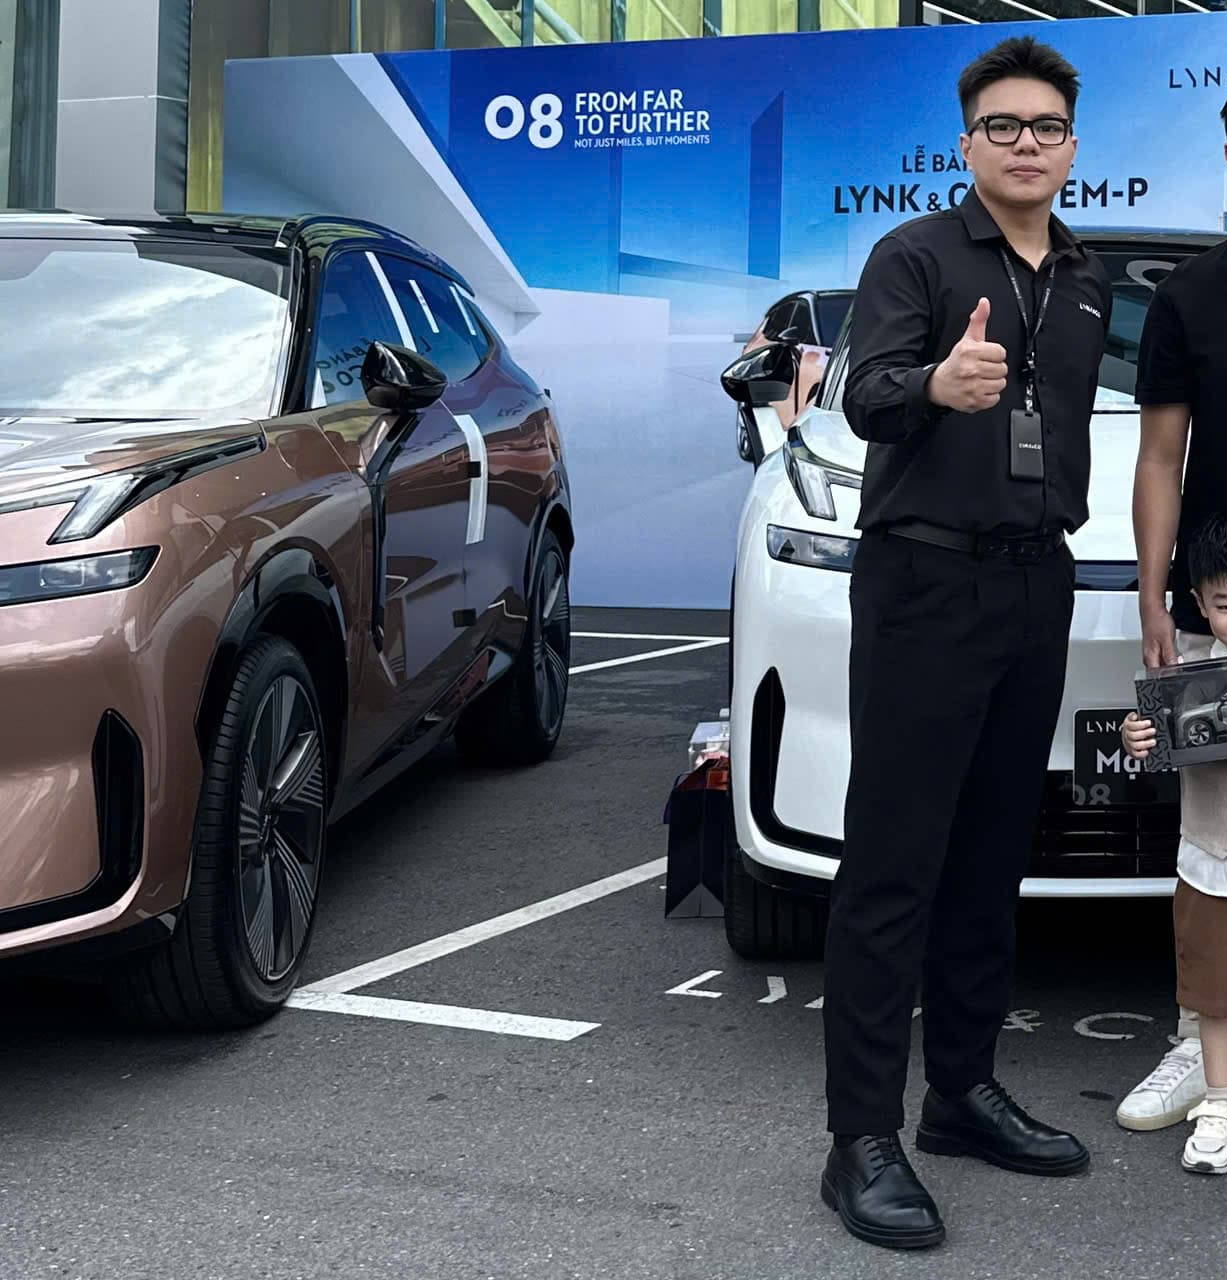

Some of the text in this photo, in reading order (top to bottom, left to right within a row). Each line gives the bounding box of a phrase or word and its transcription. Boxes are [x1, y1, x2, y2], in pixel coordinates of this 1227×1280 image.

[575, 89, 684, 113] FROM FAR
[484, 93, 564, 149] 08
[575, 110, 711, 136] TO FURTHER
[574, 138, 592, 149] NOT
[594, 137, 615, 148] JUST
[646, 135, 664, 146] BUT
[665, 134, 711, 145] MOMENTS
[902, 145, 926, 173] LỄ
[834, 177, 1149, 214] LYNK & C EM-P
